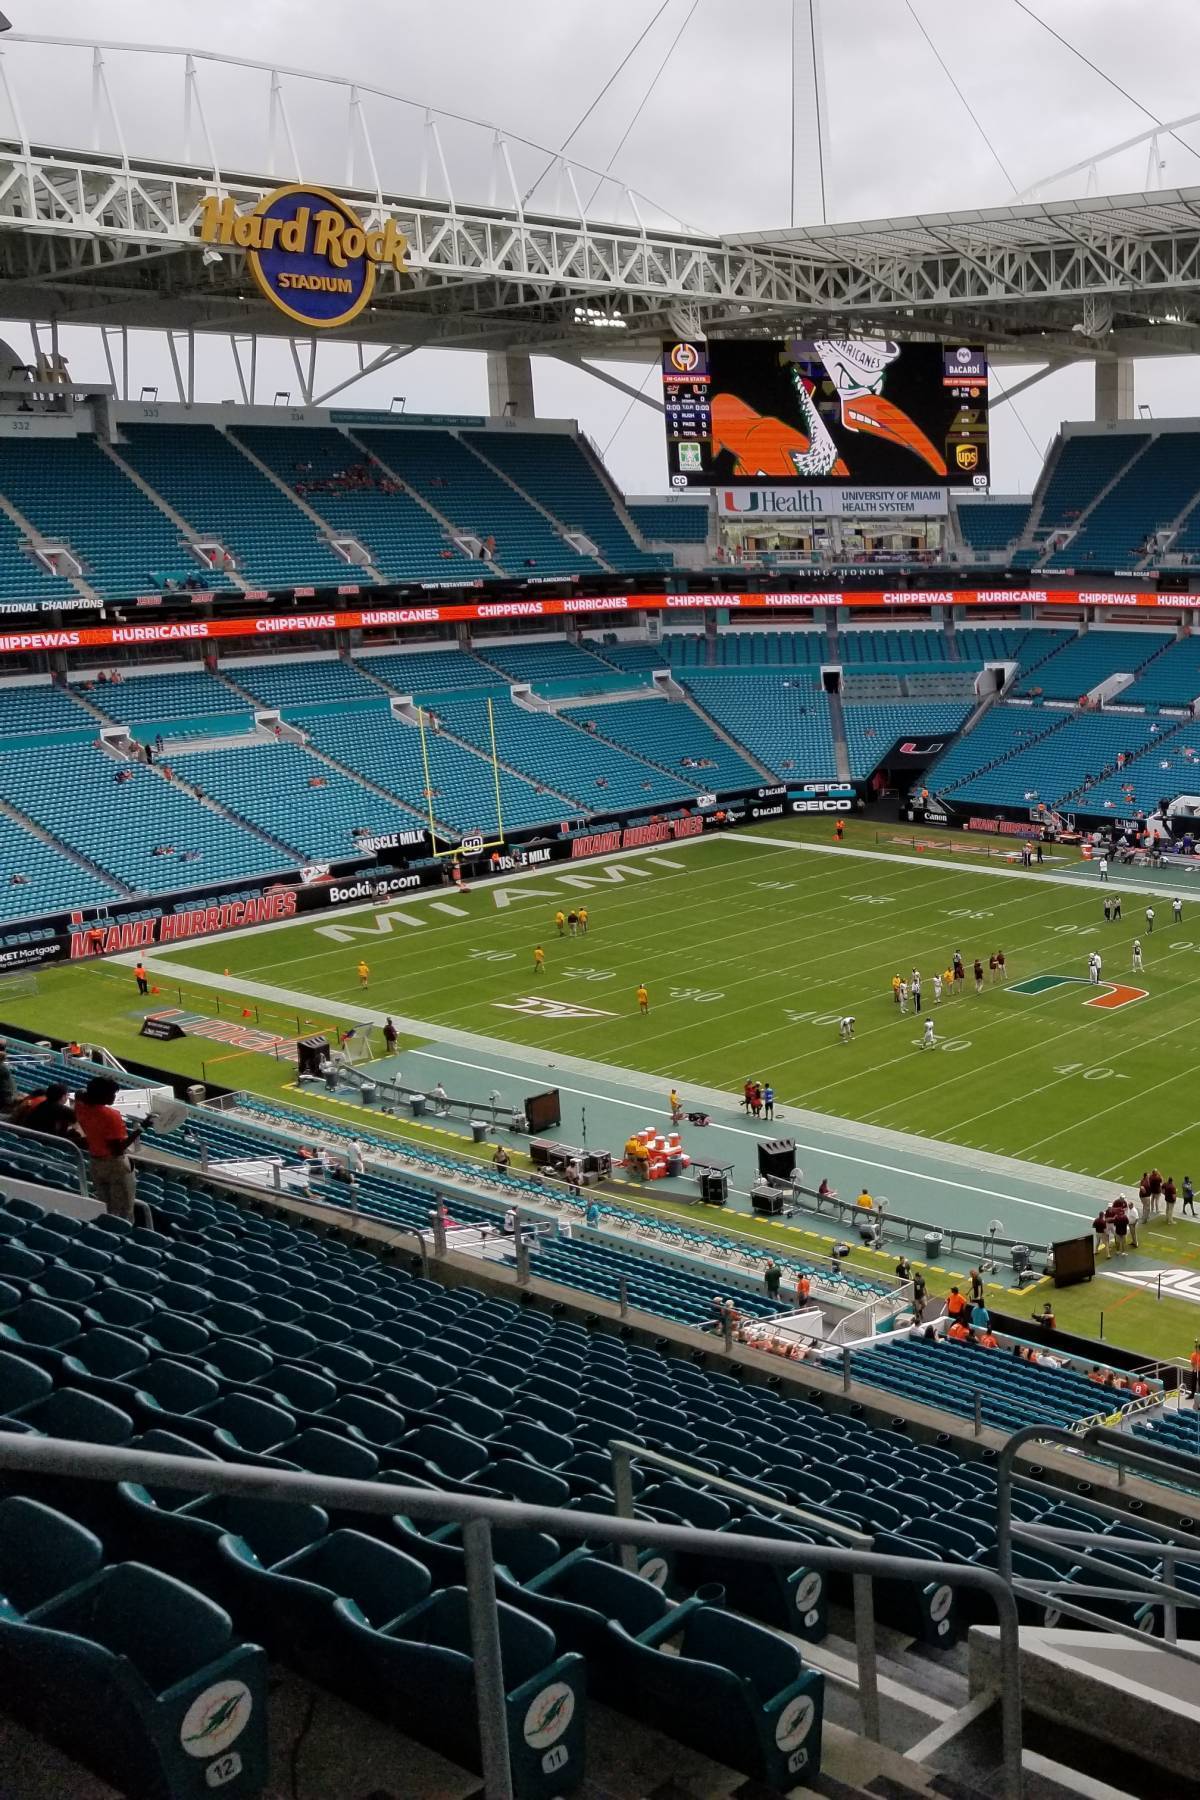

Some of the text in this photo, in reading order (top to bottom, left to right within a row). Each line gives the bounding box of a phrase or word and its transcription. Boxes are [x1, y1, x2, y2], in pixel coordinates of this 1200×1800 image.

[200, 197, 408, 273] Hard Rock
[278, 272, 353, 293] STADIUM
[958, 452, 977, 466] ups
[673, 477, 686, 485] CC
[974, 477, 986, 485] CC
[842, 491, 941, 501] UNIVERSITY OF MIAMI
[842, 502, 915, 512] HEALTH SYSTEM
[841, 569, 885, 577] HONOR
[666, 594, 843, 607] CHIPPEWAS HURRICANES
[883, 591, 1047, 603] CHIPPEWAS HURRICANES
[1078, 593, 1137, 604] CHIPPEWAS
[42, 599, 104, 611] CHAMPIONS
[478, 598, 628, 616] CHIPPEWAS HURRICANES
[256, 609, 439, 631] CHIPPEWAS HURRICANES
[112, 624, 209, 642] HURRICANES
[803, 783, 852, 792] GEICO
[792, 800, 852, 812] GEICO
[924, 812, 948, 822] Canon
[358, 830, 425, 851] MUSCLE MILK
[571, 815, 703, 857] MIAMI HURRIANES
[528, 848, 551, 865] MILK
[313, 856, 686, 942] MIAMI
[70, 891, 297, 959] MAMI HURRICANES
[20, 944, 60, 958] Mortgage
[670, 987, 725, 1002] 30
[784, 1009, 842, 1026] 40
[1053, 1062, 1114, 1080] 40
[550, 1752, 562, 1768] 11
[792, 1752, 804, 1766] 10
[213, 1758, 235, 1780] 12
